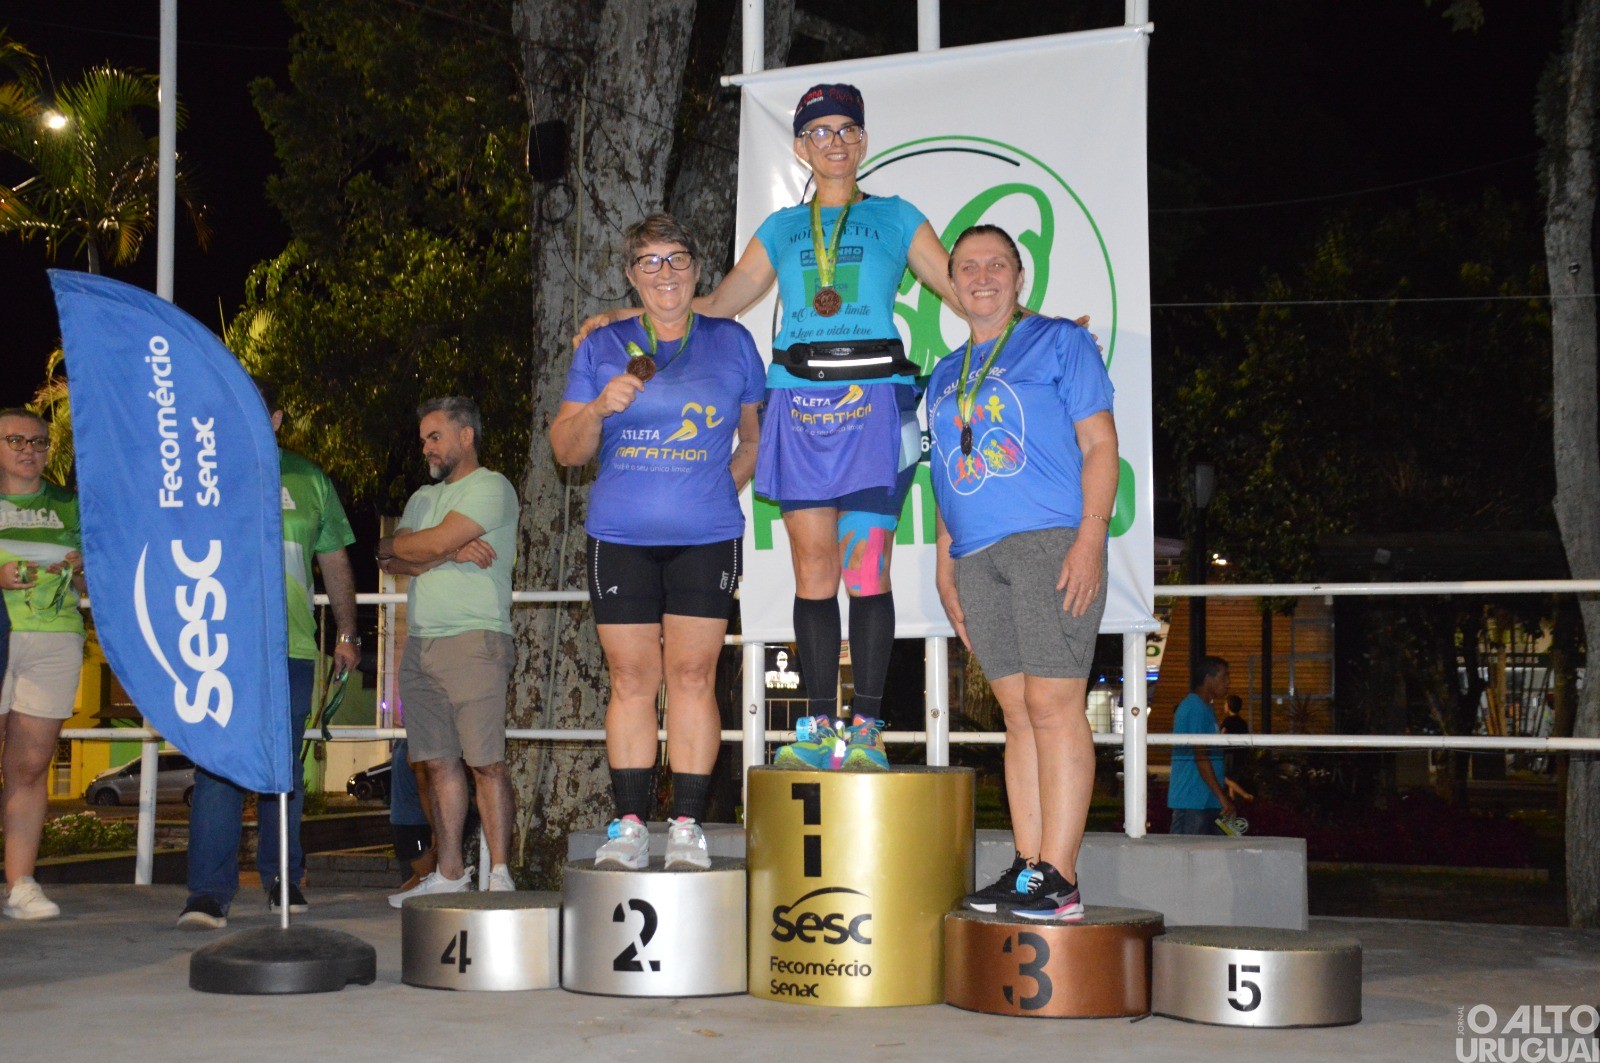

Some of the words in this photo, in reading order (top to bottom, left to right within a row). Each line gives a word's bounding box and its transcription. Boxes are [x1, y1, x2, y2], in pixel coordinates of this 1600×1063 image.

[827, 324, 850, 336] vida
[853, 324, 873, 336] leve
[145, 335, 183, 508] Fecomércio
[792, 395, 831, 407] ATLETA
[615, 446, 707, 462] MARATHON
[620, 429, 660, 440] ATLETA
[191, 416, 221, 508] Senac
[791, 782, 822, 878] 1
[440, 929, 472, 974] 4
[612, 898, 661, 973] 2
[770, 955, 872, 978] Fecomércio
[770, 979, 819, 999] Senac
[1002, 931, 1053, 1010] 3
[1227, 963, 1262, 1012] 5
